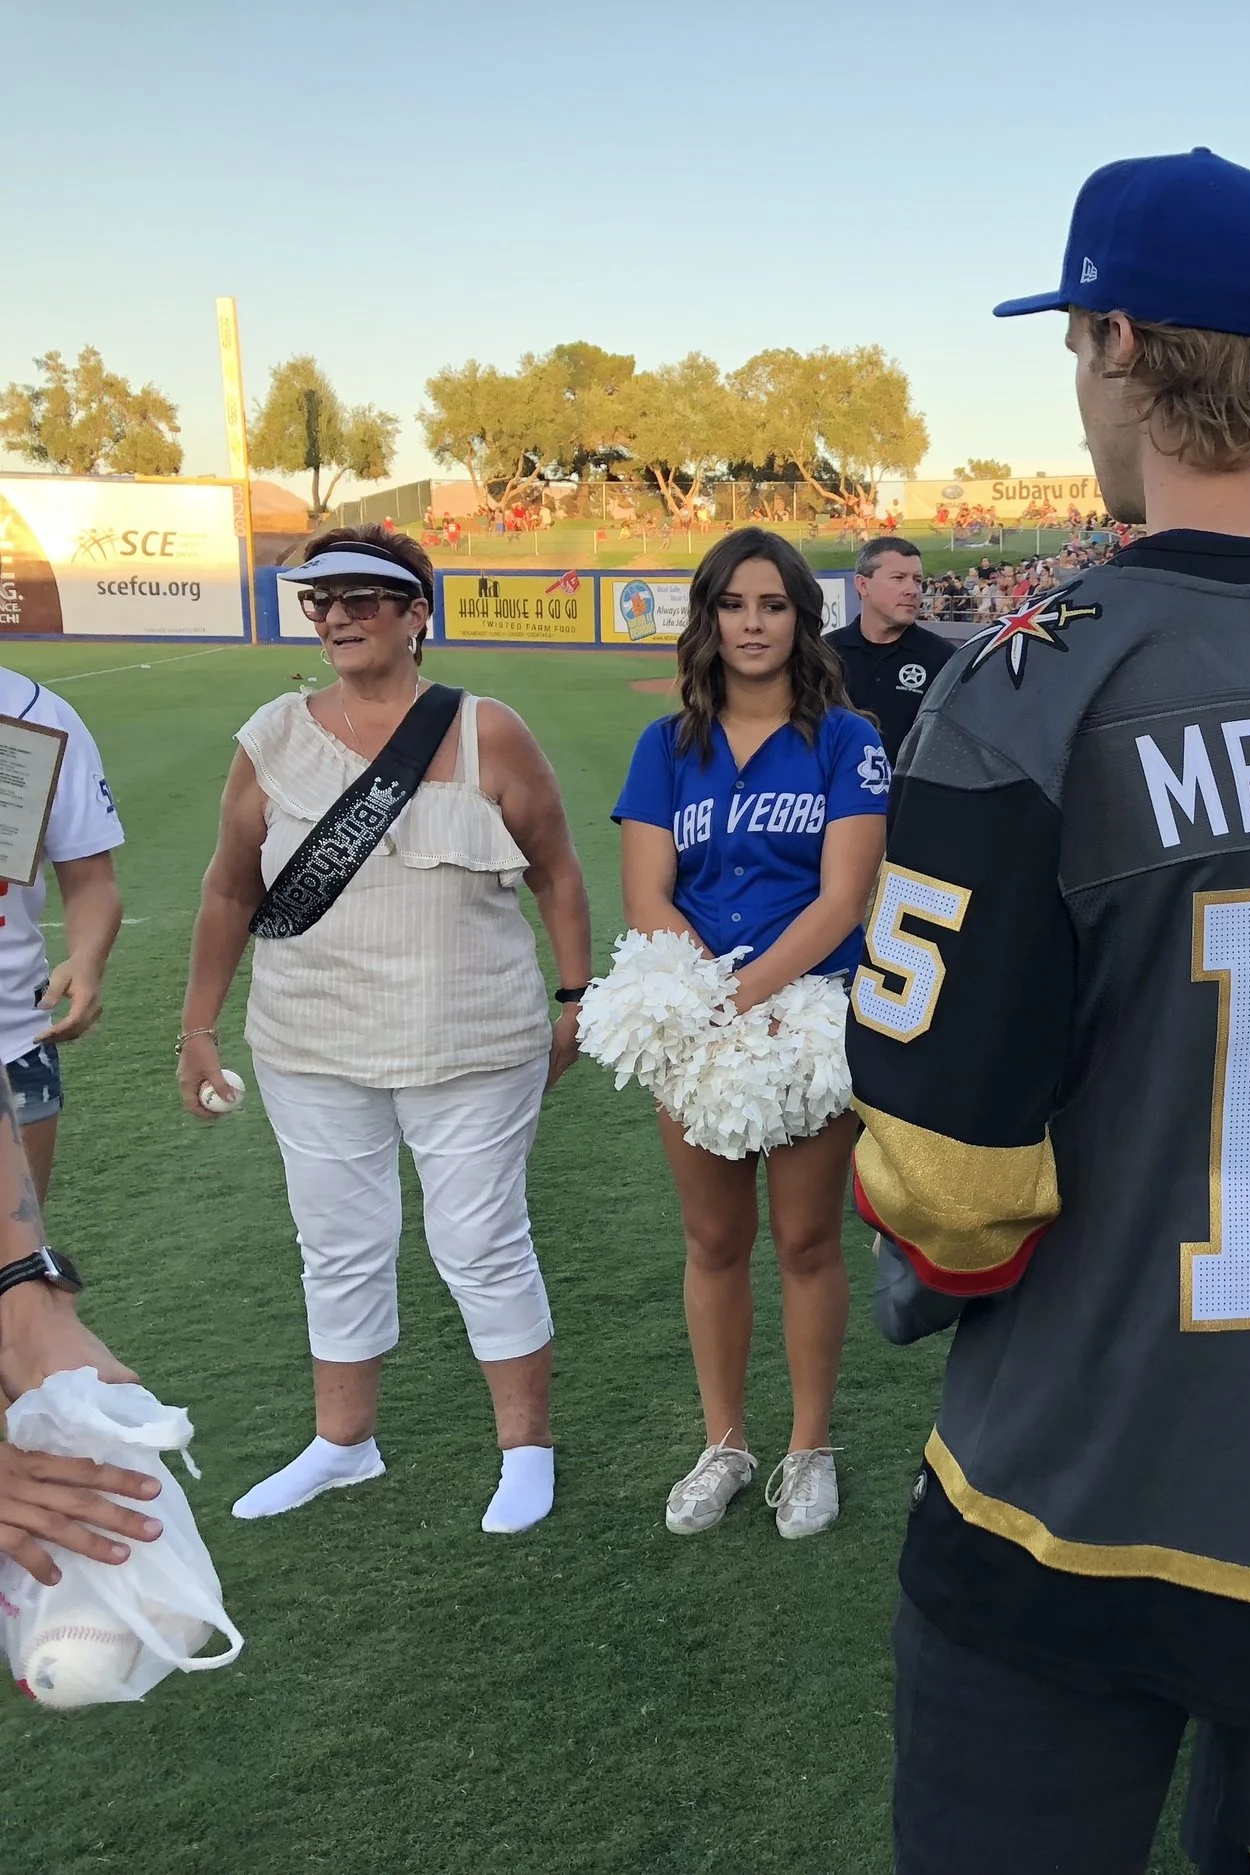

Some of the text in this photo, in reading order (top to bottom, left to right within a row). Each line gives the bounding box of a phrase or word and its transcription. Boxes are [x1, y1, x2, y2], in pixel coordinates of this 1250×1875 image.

[992, 480, 1063, 502] Subaru
[1069, 479, 1089, 499] of
[120, 530, 177, 557] SCE
[97, 575, 201, 601] scefcu.org
[459, 599, 578, 619] HASH HOUSE A GO GO
[656, 606, 680, 616] Always
[482, 620, 522, 629] TWISTED
[525, 623, 551, 632] FARM
[663, 619, 674, 627] Life
[673, 792, 826, 852] LAS VEGAS
[273, 801, 392, 922] Birthday
